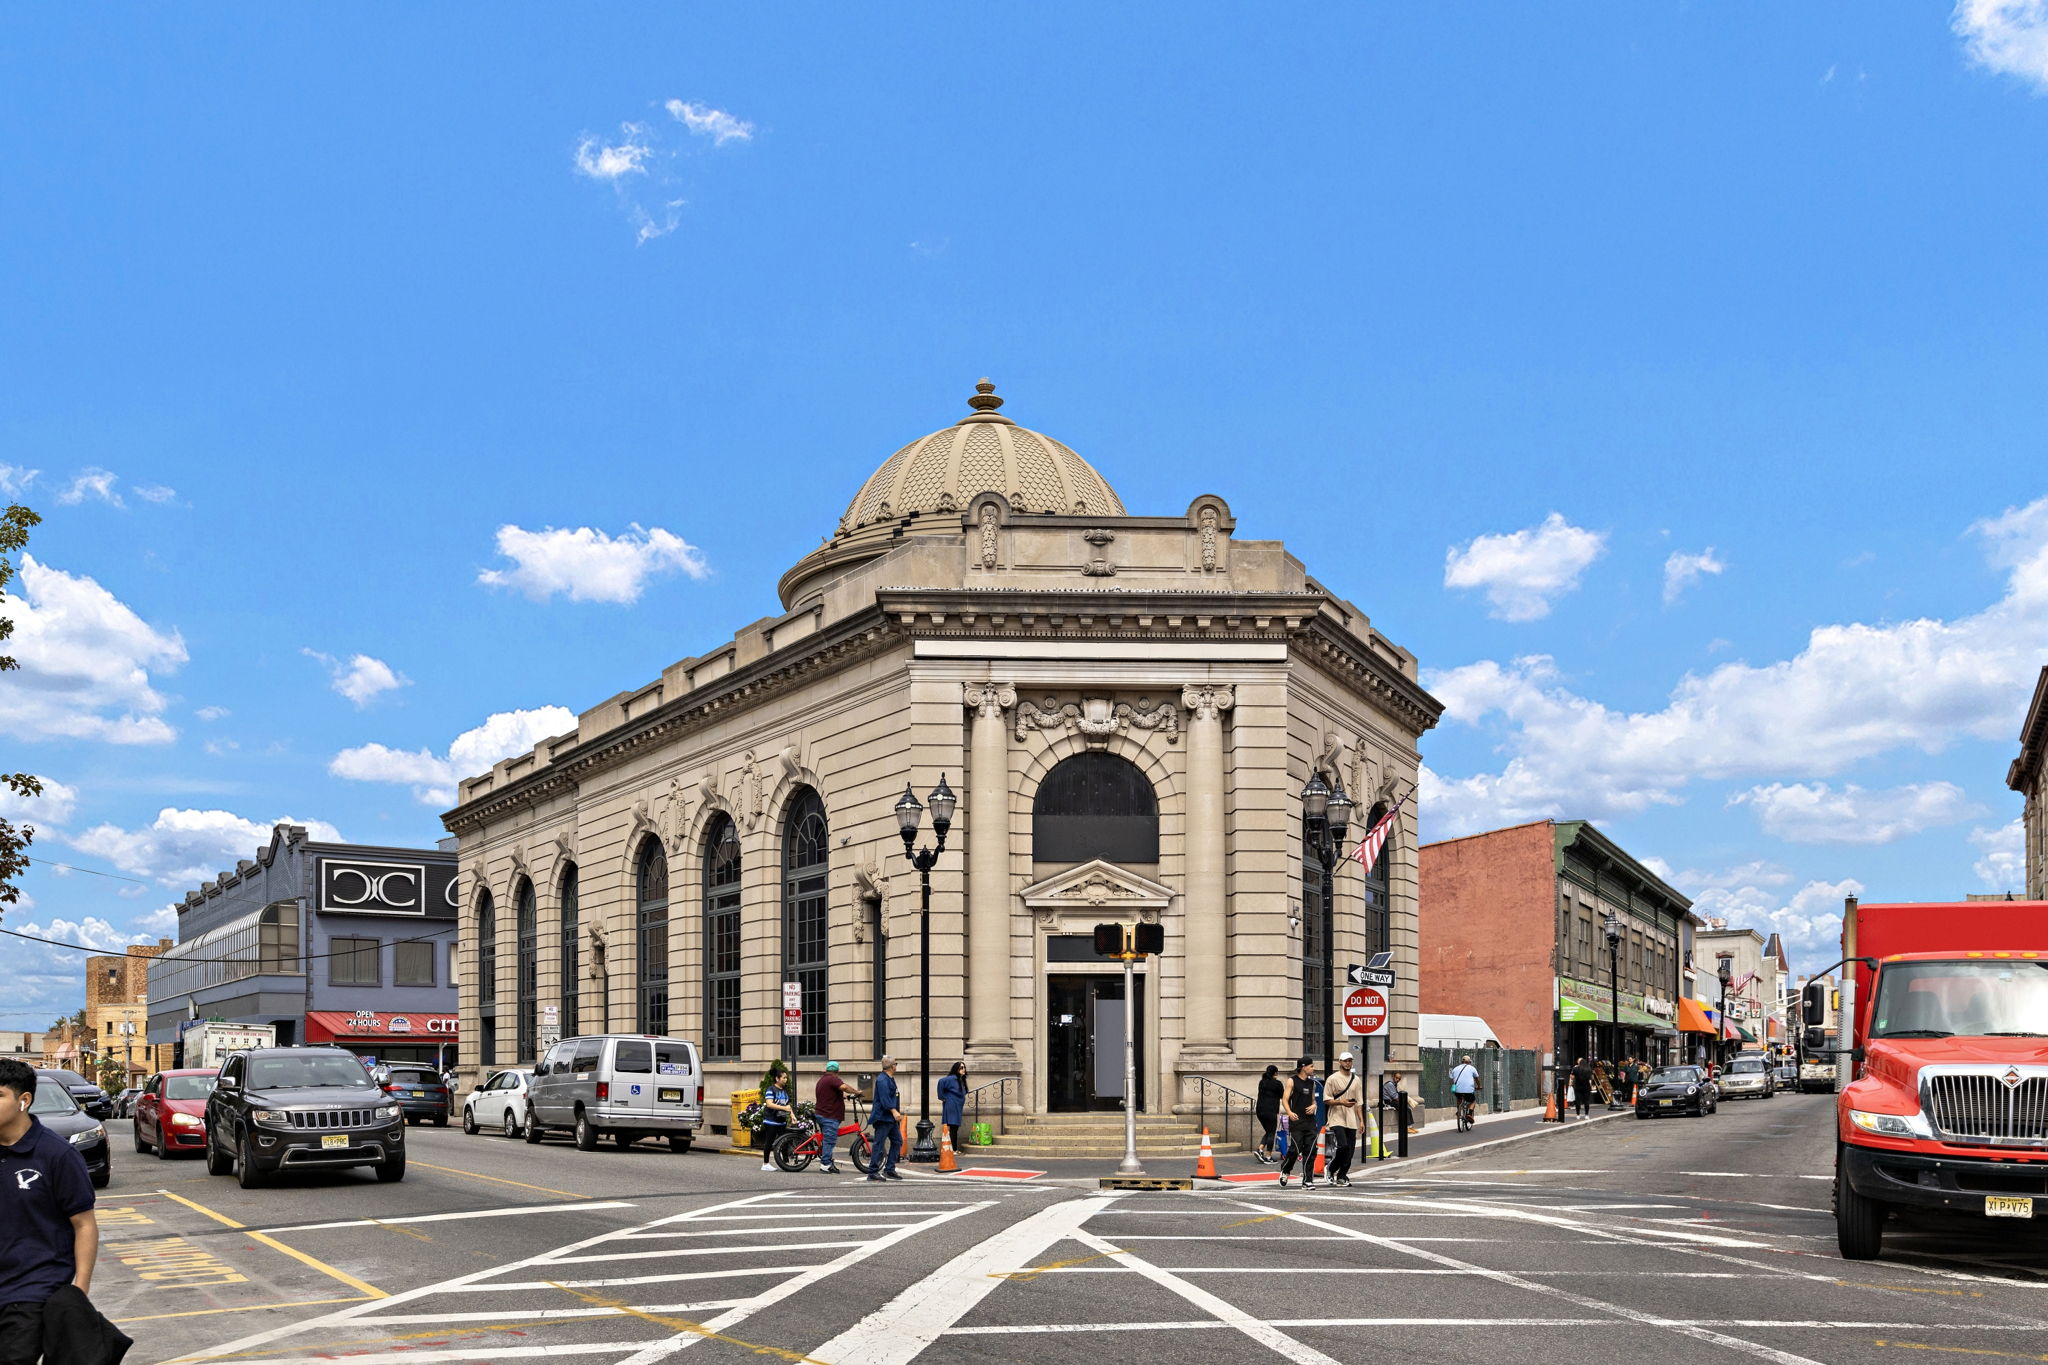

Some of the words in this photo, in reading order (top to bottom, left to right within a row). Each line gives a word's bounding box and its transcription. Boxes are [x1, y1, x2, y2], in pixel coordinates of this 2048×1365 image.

[1360, 971, 1374, 981] ONE
[1375, 974, 1390, 984] WAY
[1350, 996, 1362, 1005] DO
[1364, 996, 1380, 1005] NOT
[356, 1010, 375, 1018] OPEN
[358, 1019, 381, 1027] HOURS
[1352, 1017, 1378, 1026] ENTER
